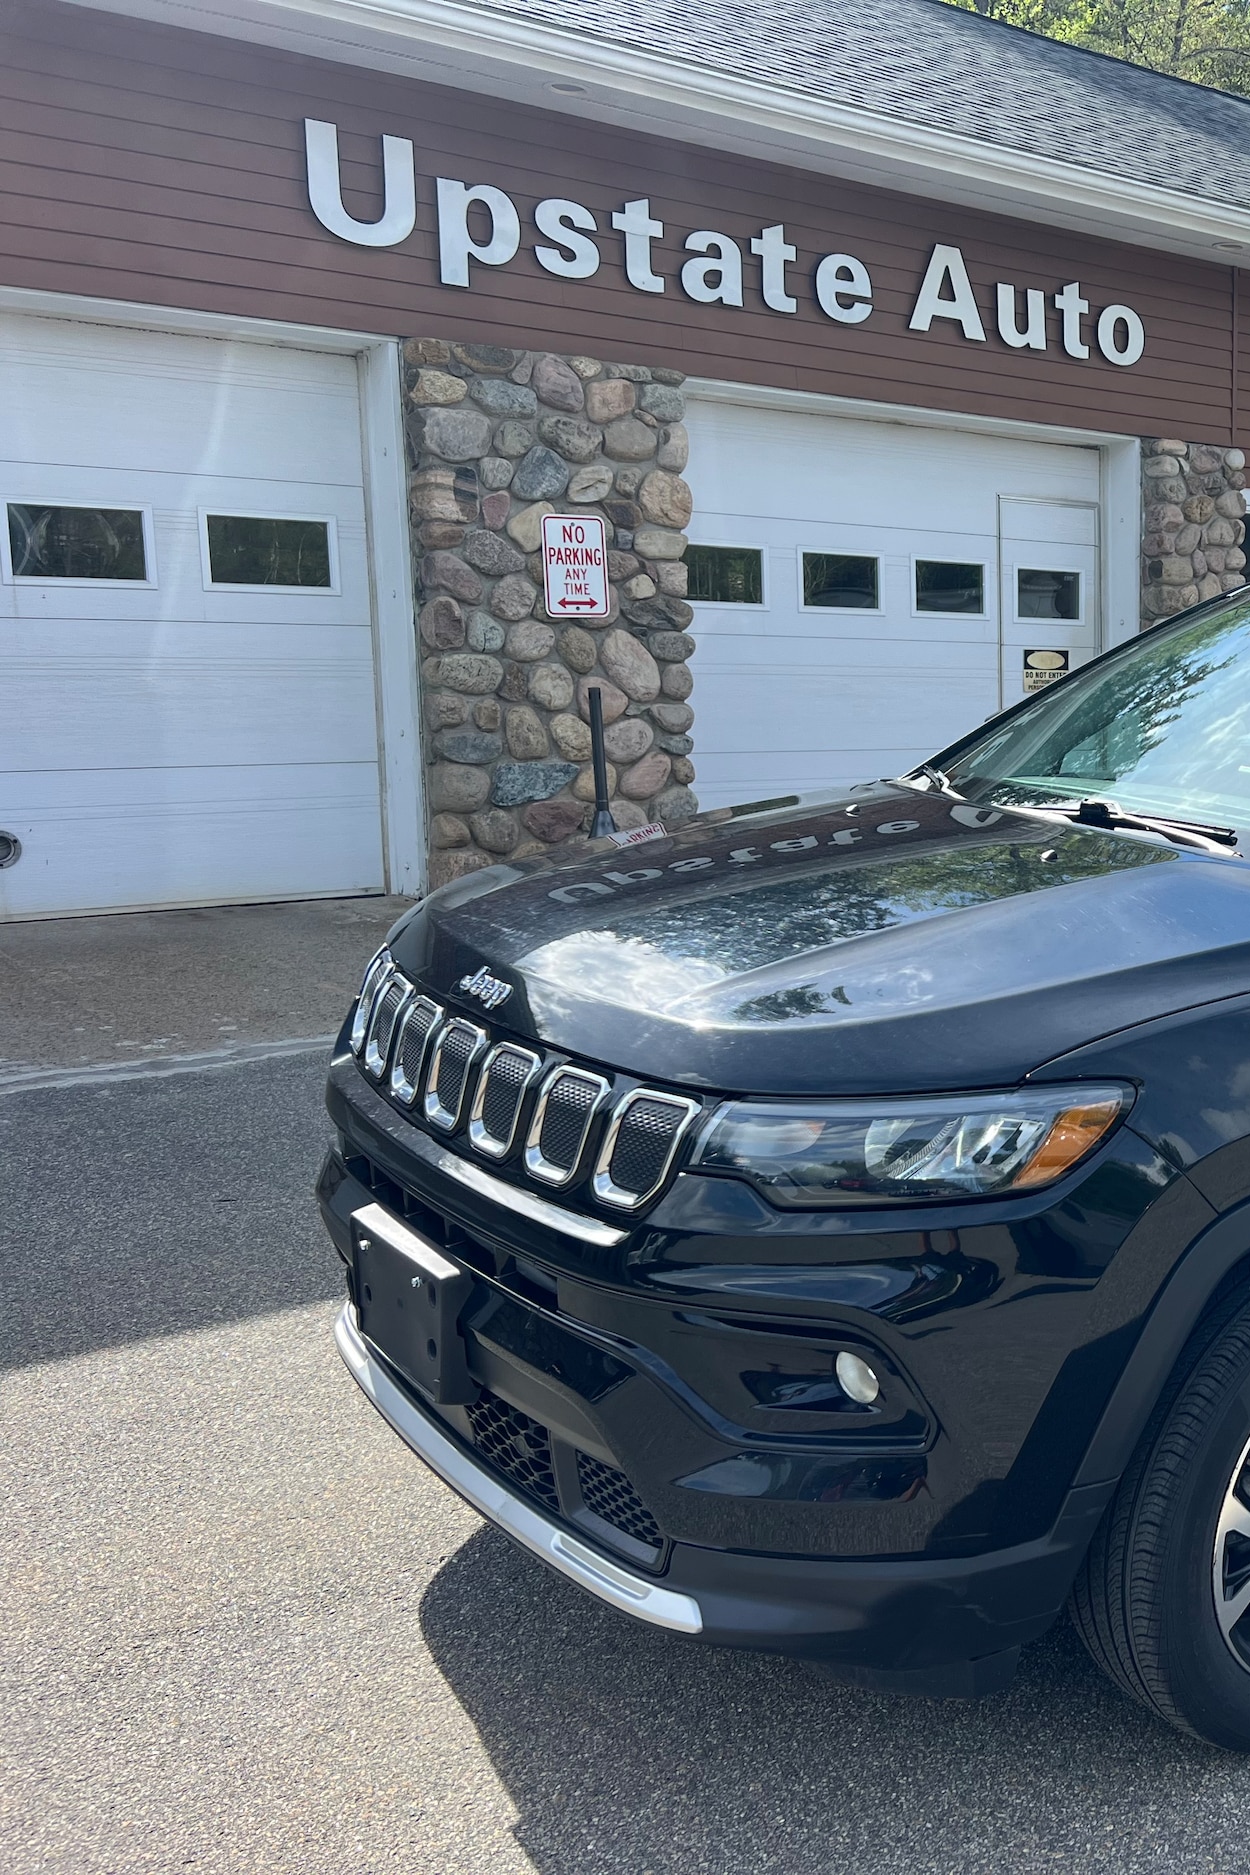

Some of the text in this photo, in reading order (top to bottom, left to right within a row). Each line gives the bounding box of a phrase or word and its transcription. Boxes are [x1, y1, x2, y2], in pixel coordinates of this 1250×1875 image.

[304, 117, 1146, 367] Upstate Auto
[562, 525, 585, 543] NO
[548, 547, 601, 566] PARKING
[565, 568, 588, 580] ANY
[564, 583, 590, 596] TIME
[1025, 671, 1034, 679] DO
[1035, 671, 1047, 679] NOT
[459, 965, 514, 1010] Jeep
